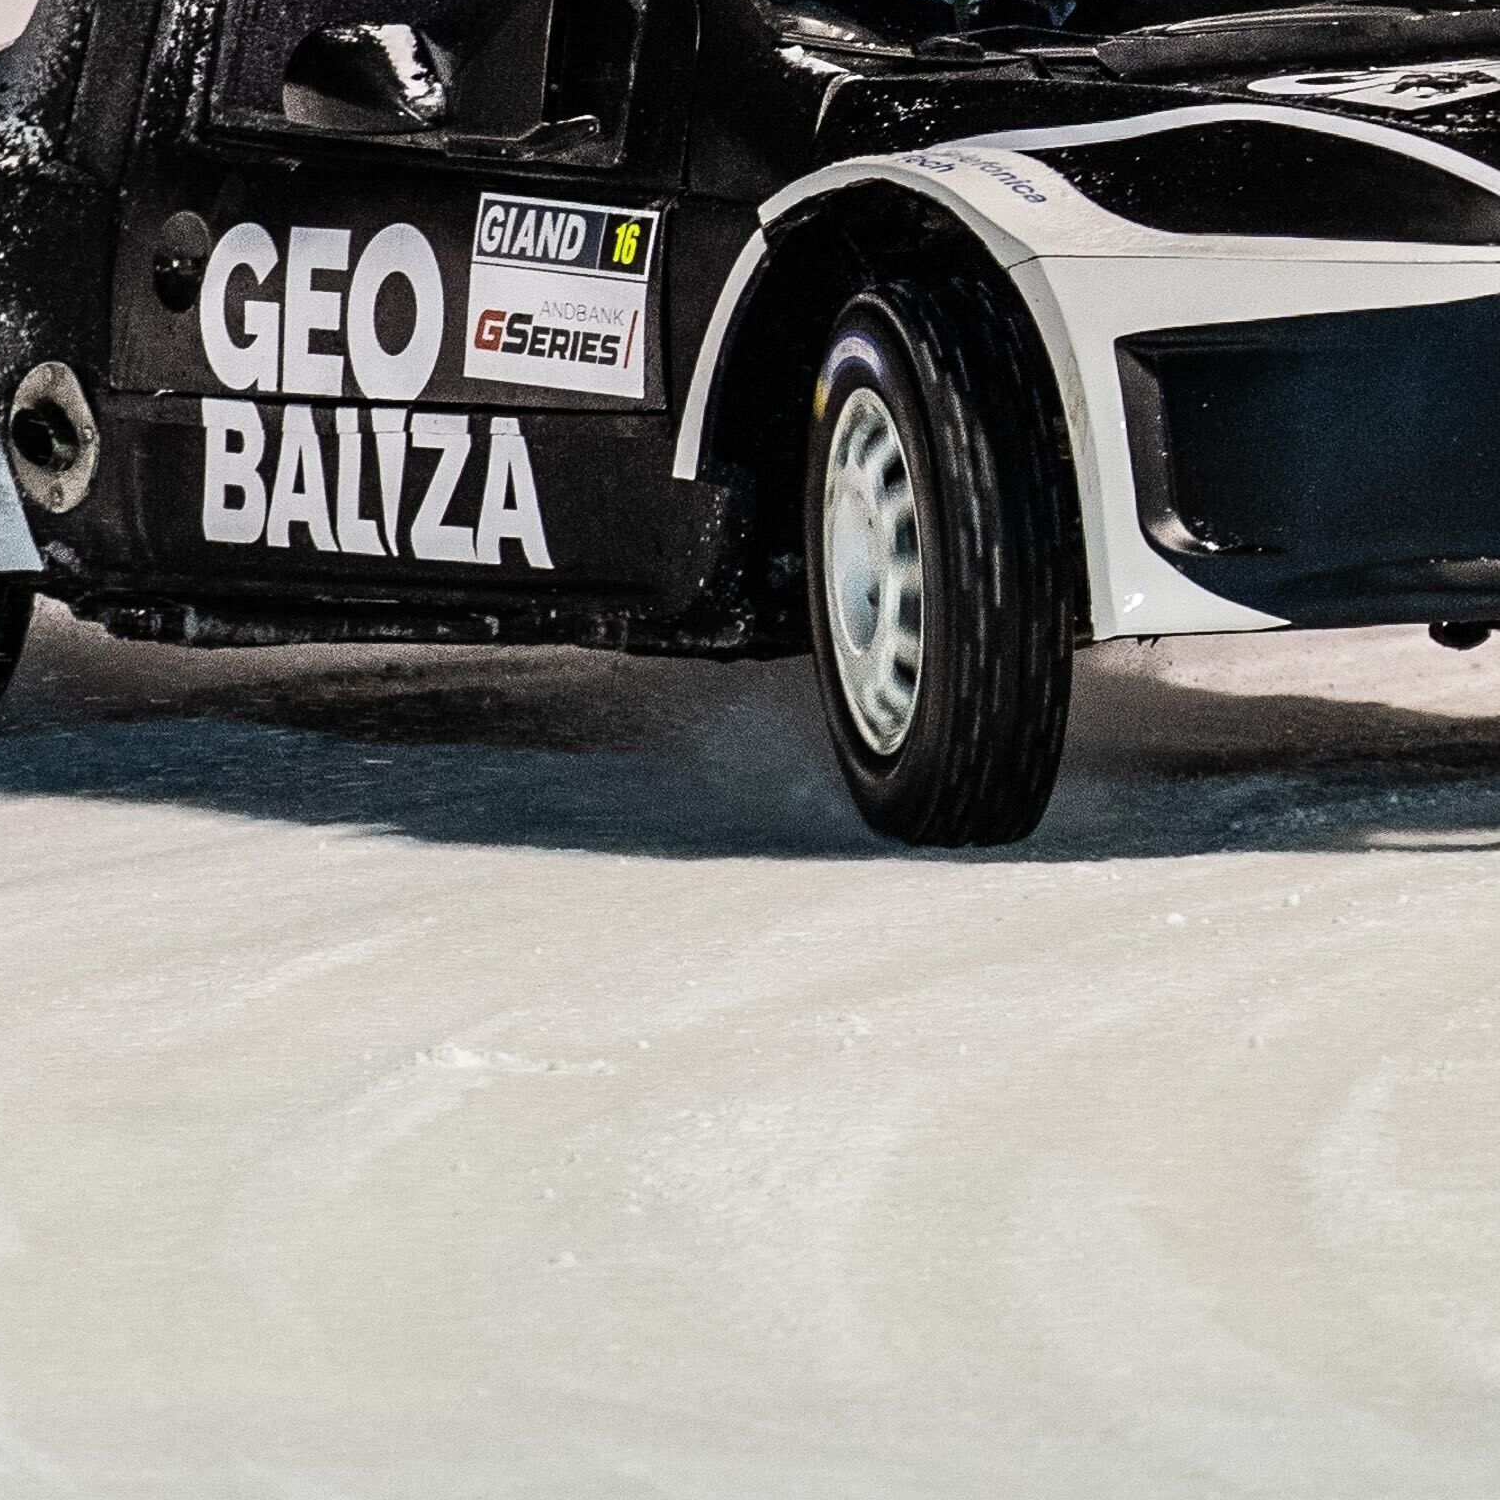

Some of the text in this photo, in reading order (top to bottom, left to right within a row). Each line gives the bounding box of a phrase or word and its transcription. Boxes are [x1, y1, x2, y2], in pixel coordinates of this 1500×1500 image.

[480, 204, 641, 265] GIAND 16
[199, 222, 445, 400] GEO
[541, 301, 625, 326] ANDBANK
[201, 398, 554, 569] BALIZA
